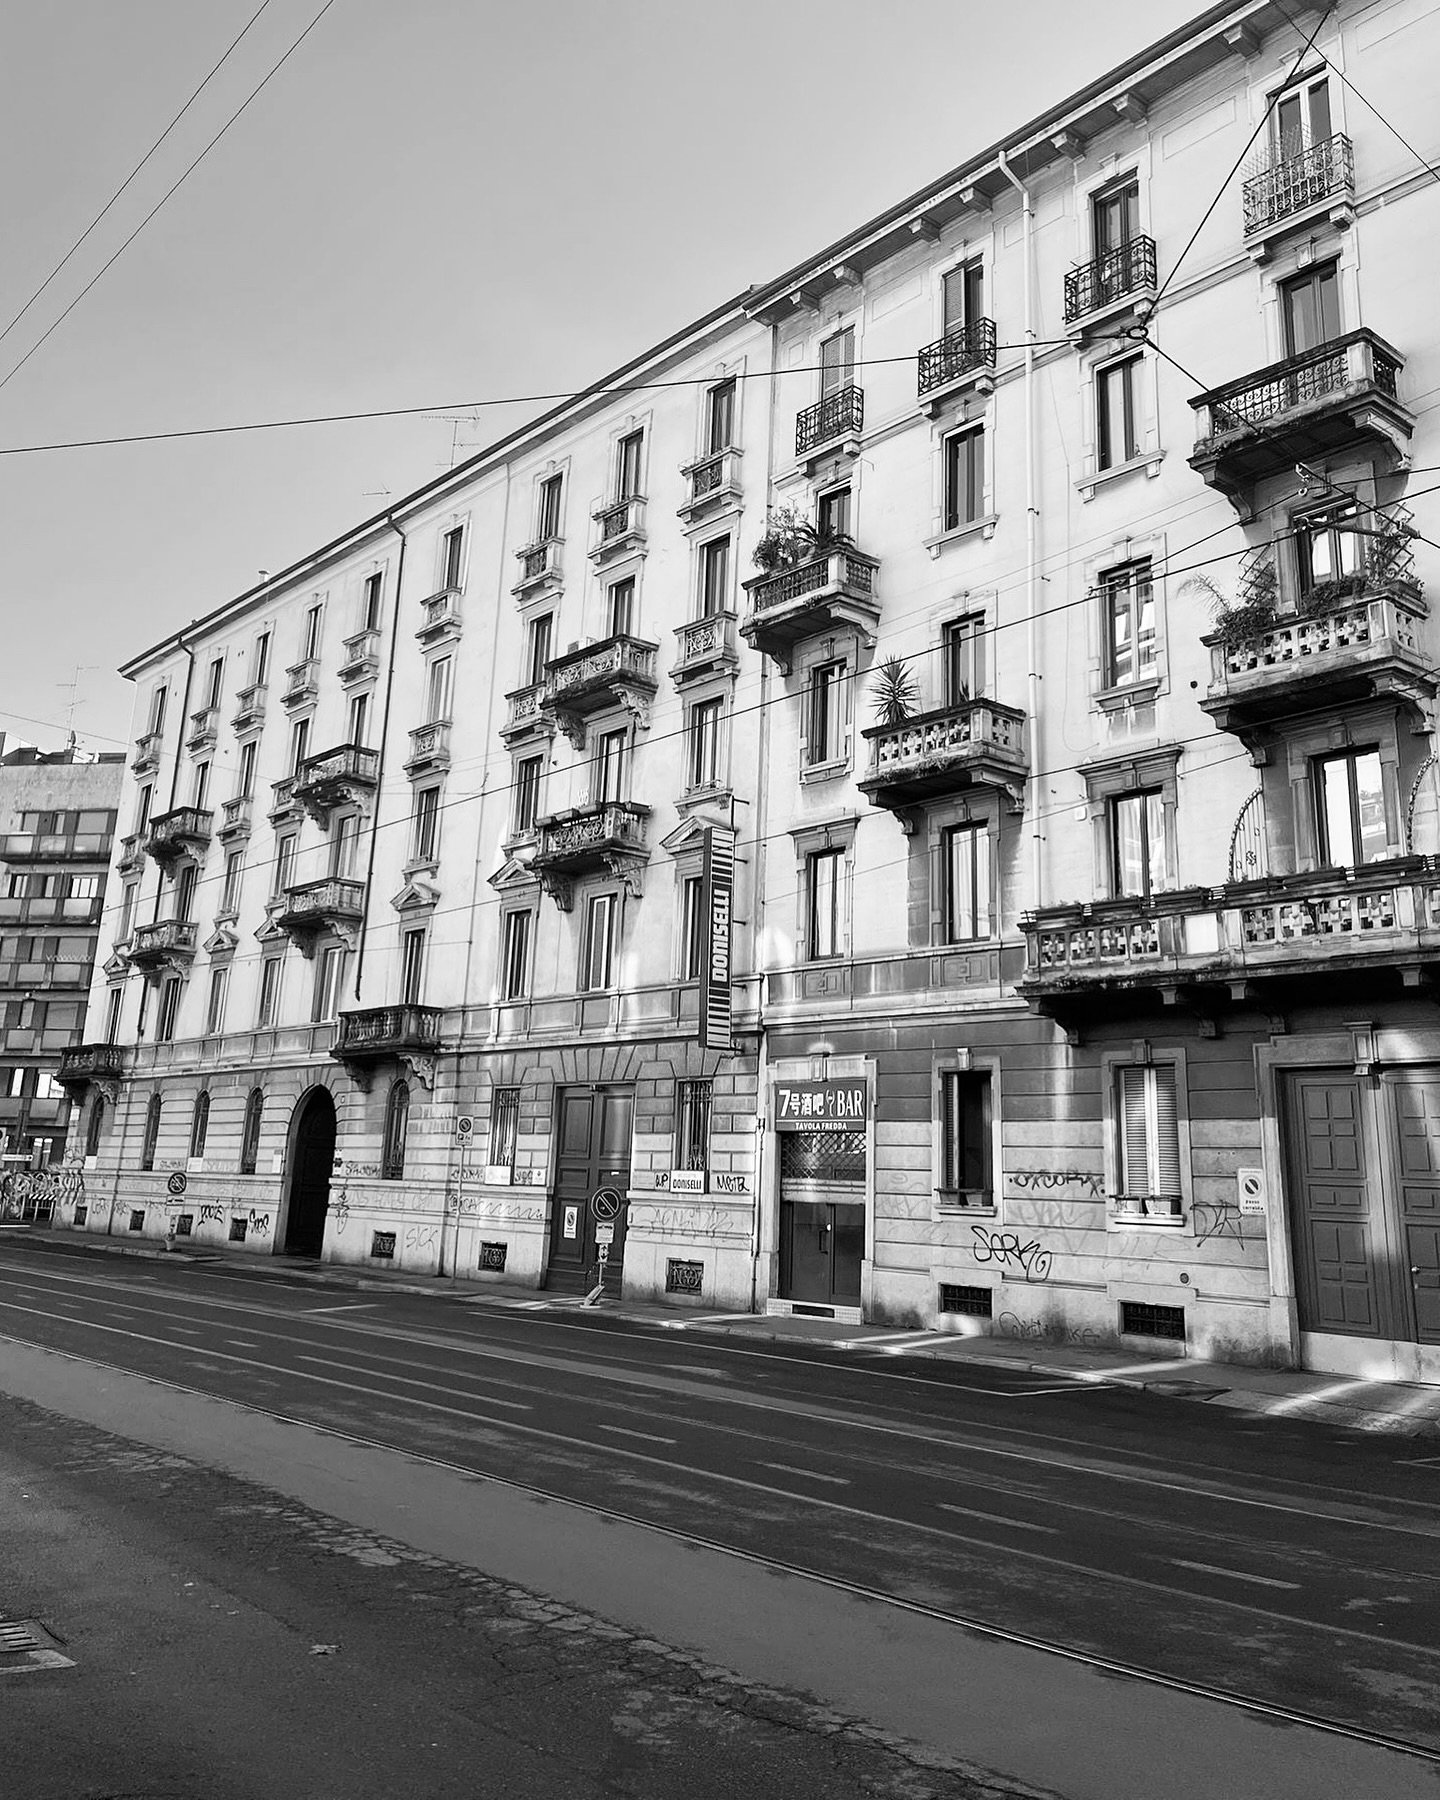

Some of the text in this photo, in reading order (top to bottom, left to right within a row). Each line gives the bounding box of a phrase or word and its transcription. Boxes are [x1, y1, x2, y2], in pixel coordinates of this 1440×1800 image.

[712, 888, 730, 982] DONISELLI
[778, 1089, 863, 1117] 7号酒吧 BAR
[795, 1122, 847, 1131] TAVOLA FREDDA
